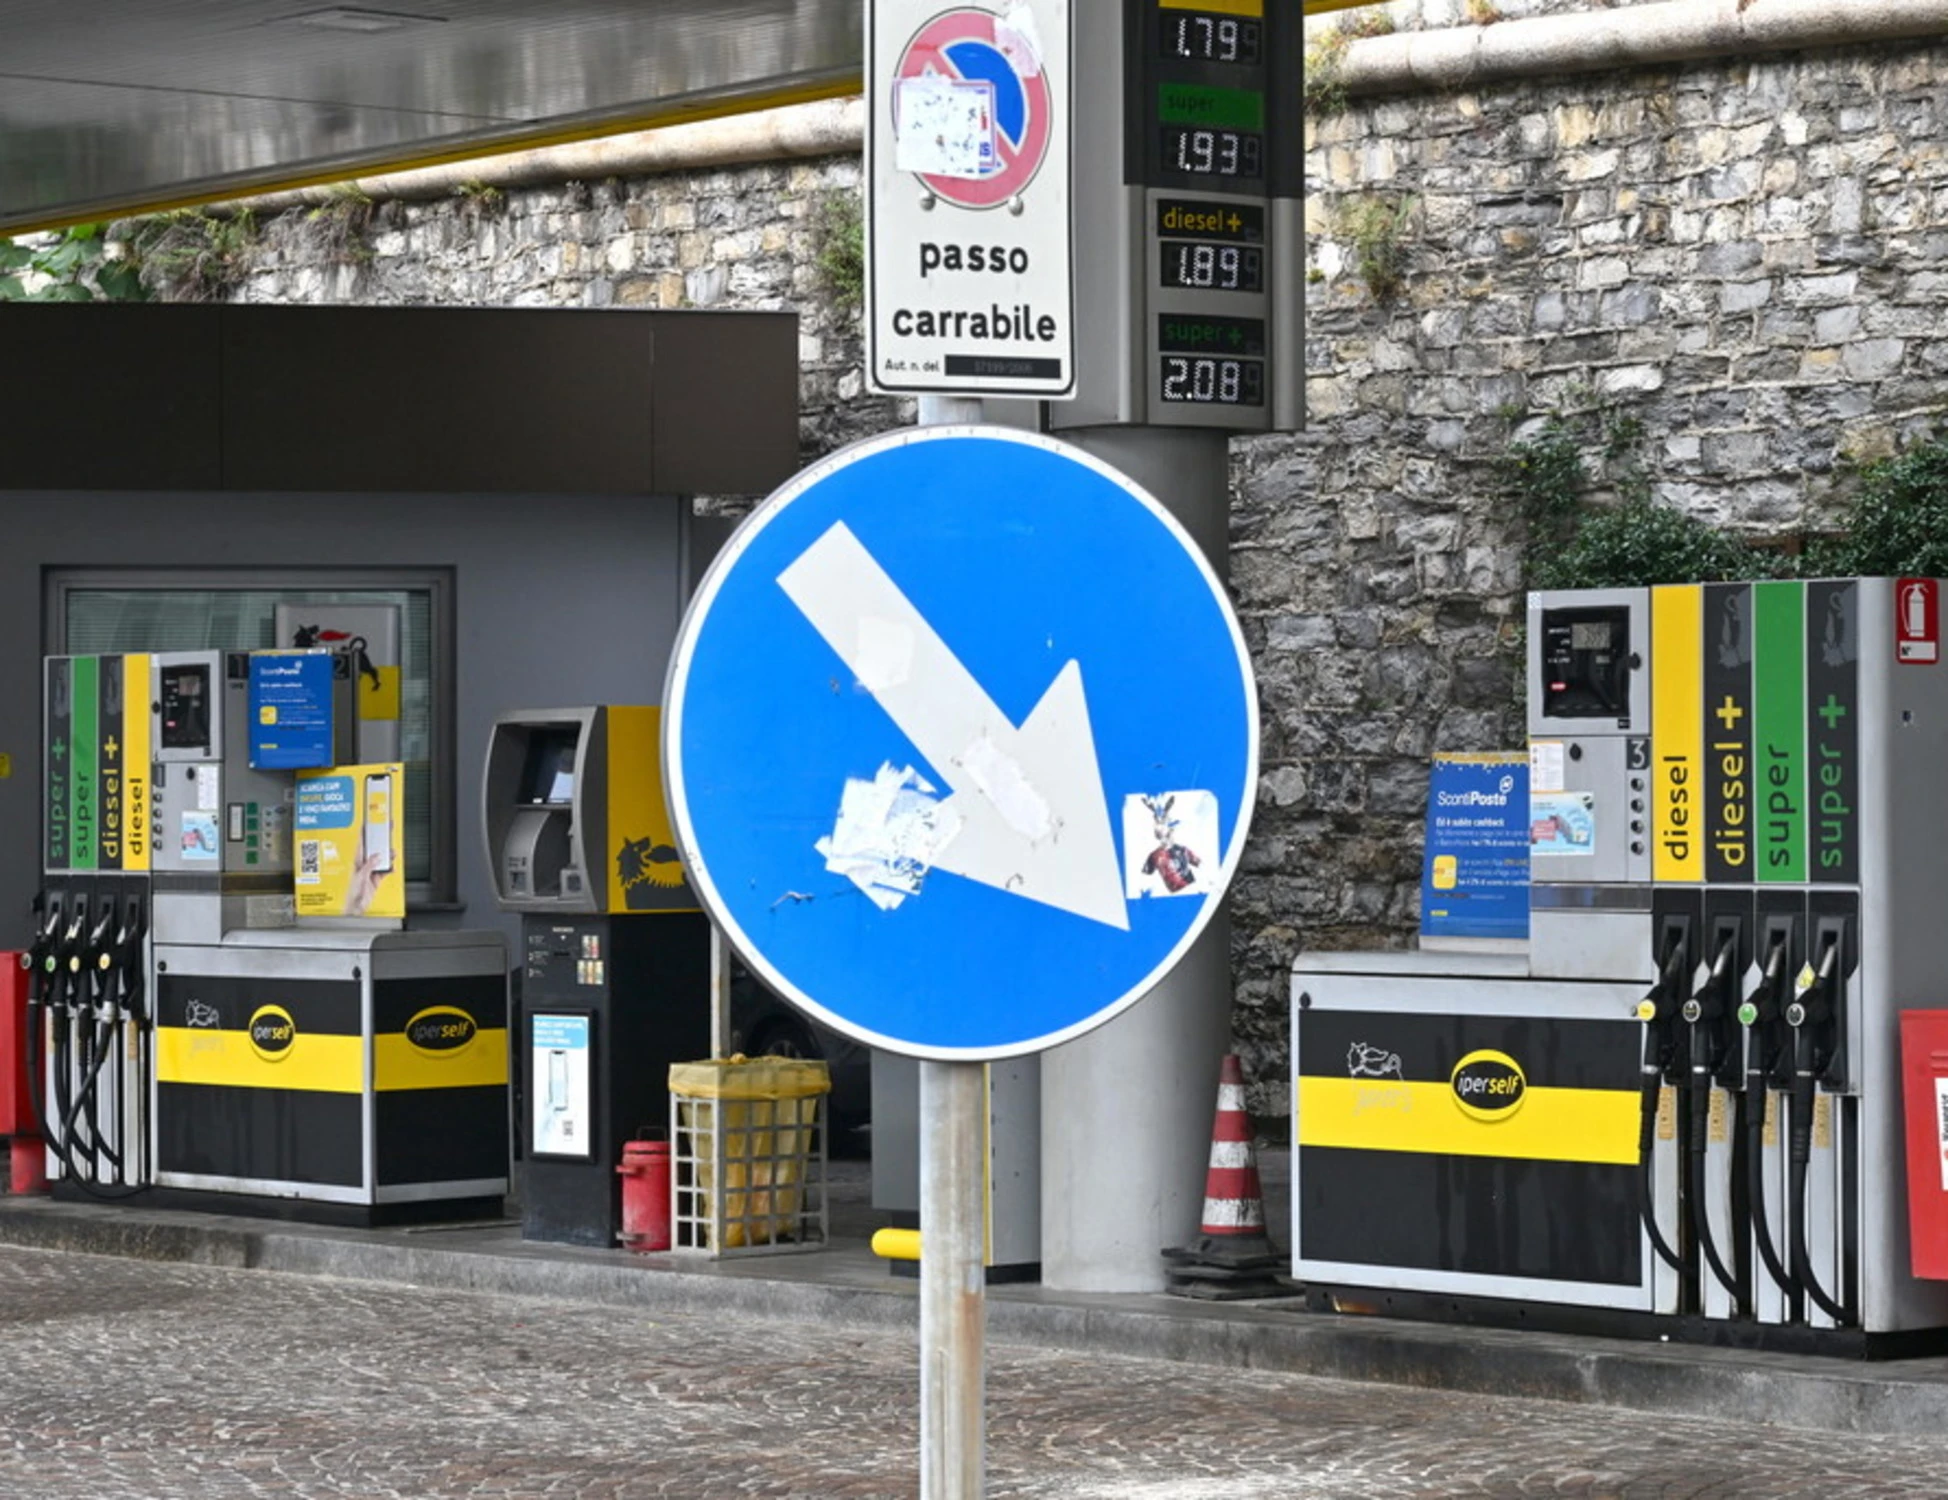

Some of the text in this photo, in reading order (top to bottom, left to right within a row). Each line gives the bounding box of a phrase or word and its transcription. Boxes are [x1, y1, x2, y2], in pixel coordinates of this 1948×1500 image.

[1166, 94, 1215, 116] super
[919, 242, 1028, 278] passo
[892, 303, 1057, 341] carrabile
[1631, 740, 1645, 768] 3
[51, 770, 66, 857] super
[76, 770, 92, 858] super
[102, 768, 119, 859] diesel
[129, 778, 143, 856] diesel
[1437, 790, 1507, 806] ScontiPoste
[1663, 756, 1689, 861] diesel
[1714, 742, 1745, 866] diesel
[1768, 743, 1797, 867] super
[1820, 743, 1849, 867] super
[253, 1021, 292, 1041] iperself
[413, 1021, 469, 1043] iperself
[1458, 1070, 1519, 1096] iperself
